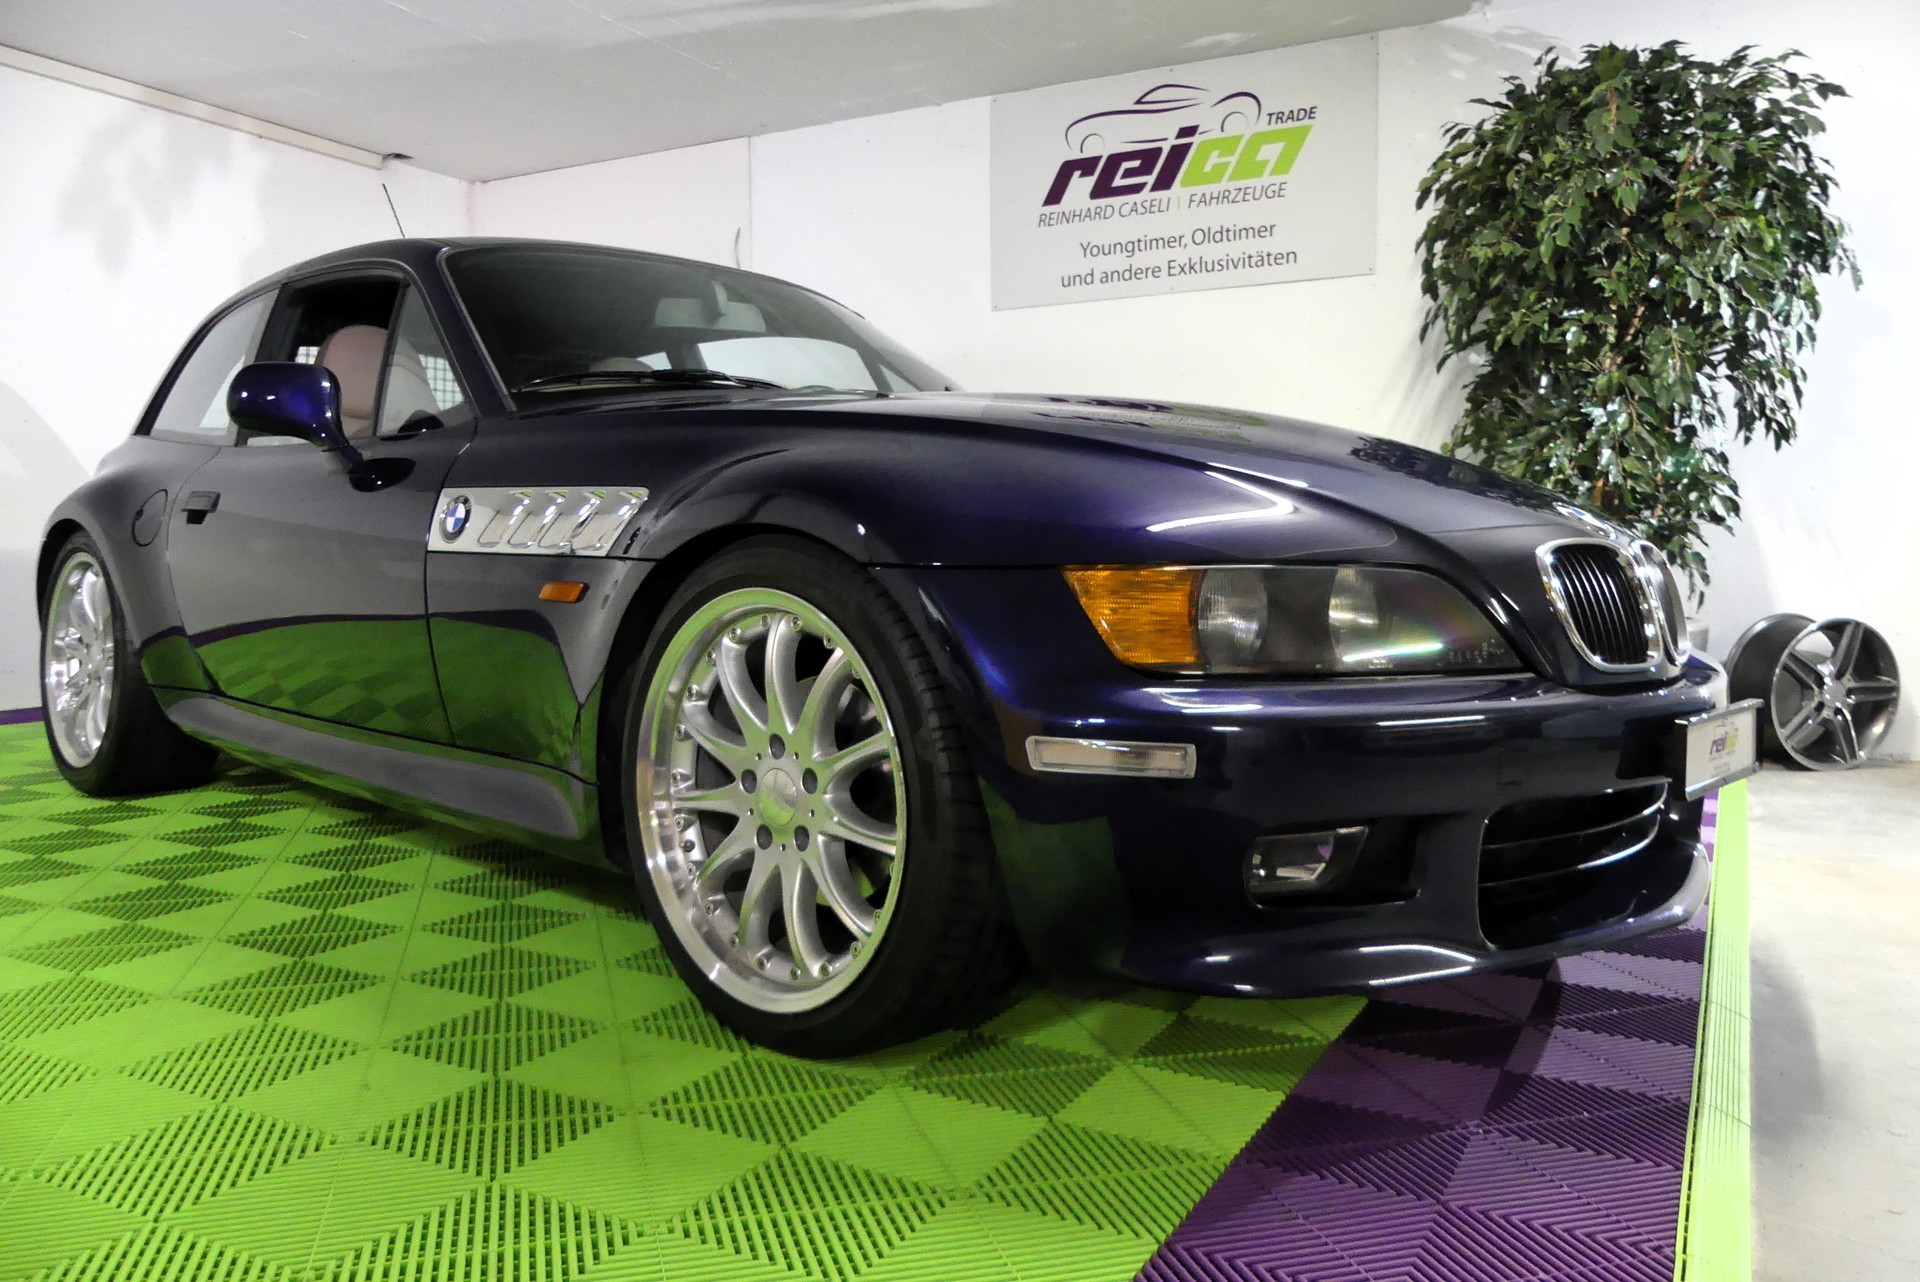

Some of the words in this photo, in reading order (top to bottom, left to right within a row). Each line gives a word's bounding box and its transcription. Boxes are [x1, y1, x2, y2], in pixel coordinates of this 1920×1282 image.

[1266, 106, 1318, 126] TRADE
[1041, 124, 1314, 207] reica
[1038, 205, 1115, 228] REINHARD
[1118, 197, 1171, 218] CASELI
[1188, 182, 1287, 208] FAHRZEUGE
[1080, 235, 1188, 258] Youngtimer,
[1191, 223, 1276, 246] Oldtimer
[1061, 268, 1095, 288] und
[1100, 264, 1162, 285] andere
[1167, 250, 1298, 277] Exklusivitäten
